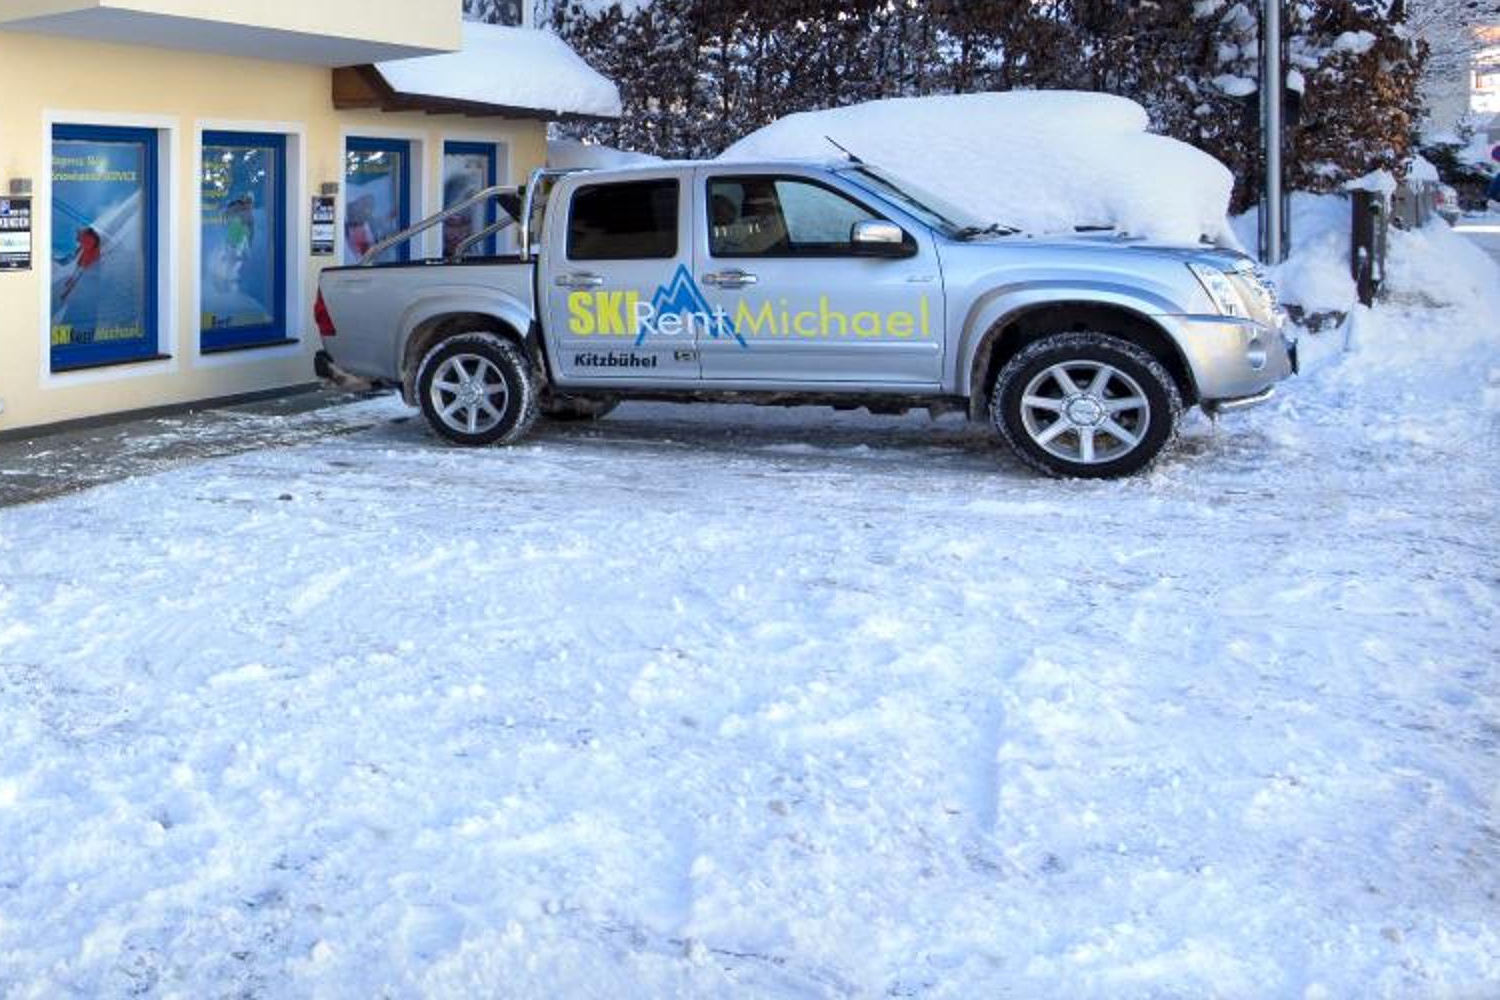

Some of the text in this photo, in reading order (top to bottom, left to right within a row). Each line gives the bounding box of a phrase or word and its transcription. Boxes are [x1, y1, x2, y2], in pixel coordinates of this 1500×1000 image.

[634, 301, 728, 336] Rent
[734, 294, 932, 337] Michael
[574, 352, 658, 368] Kitzbühel
